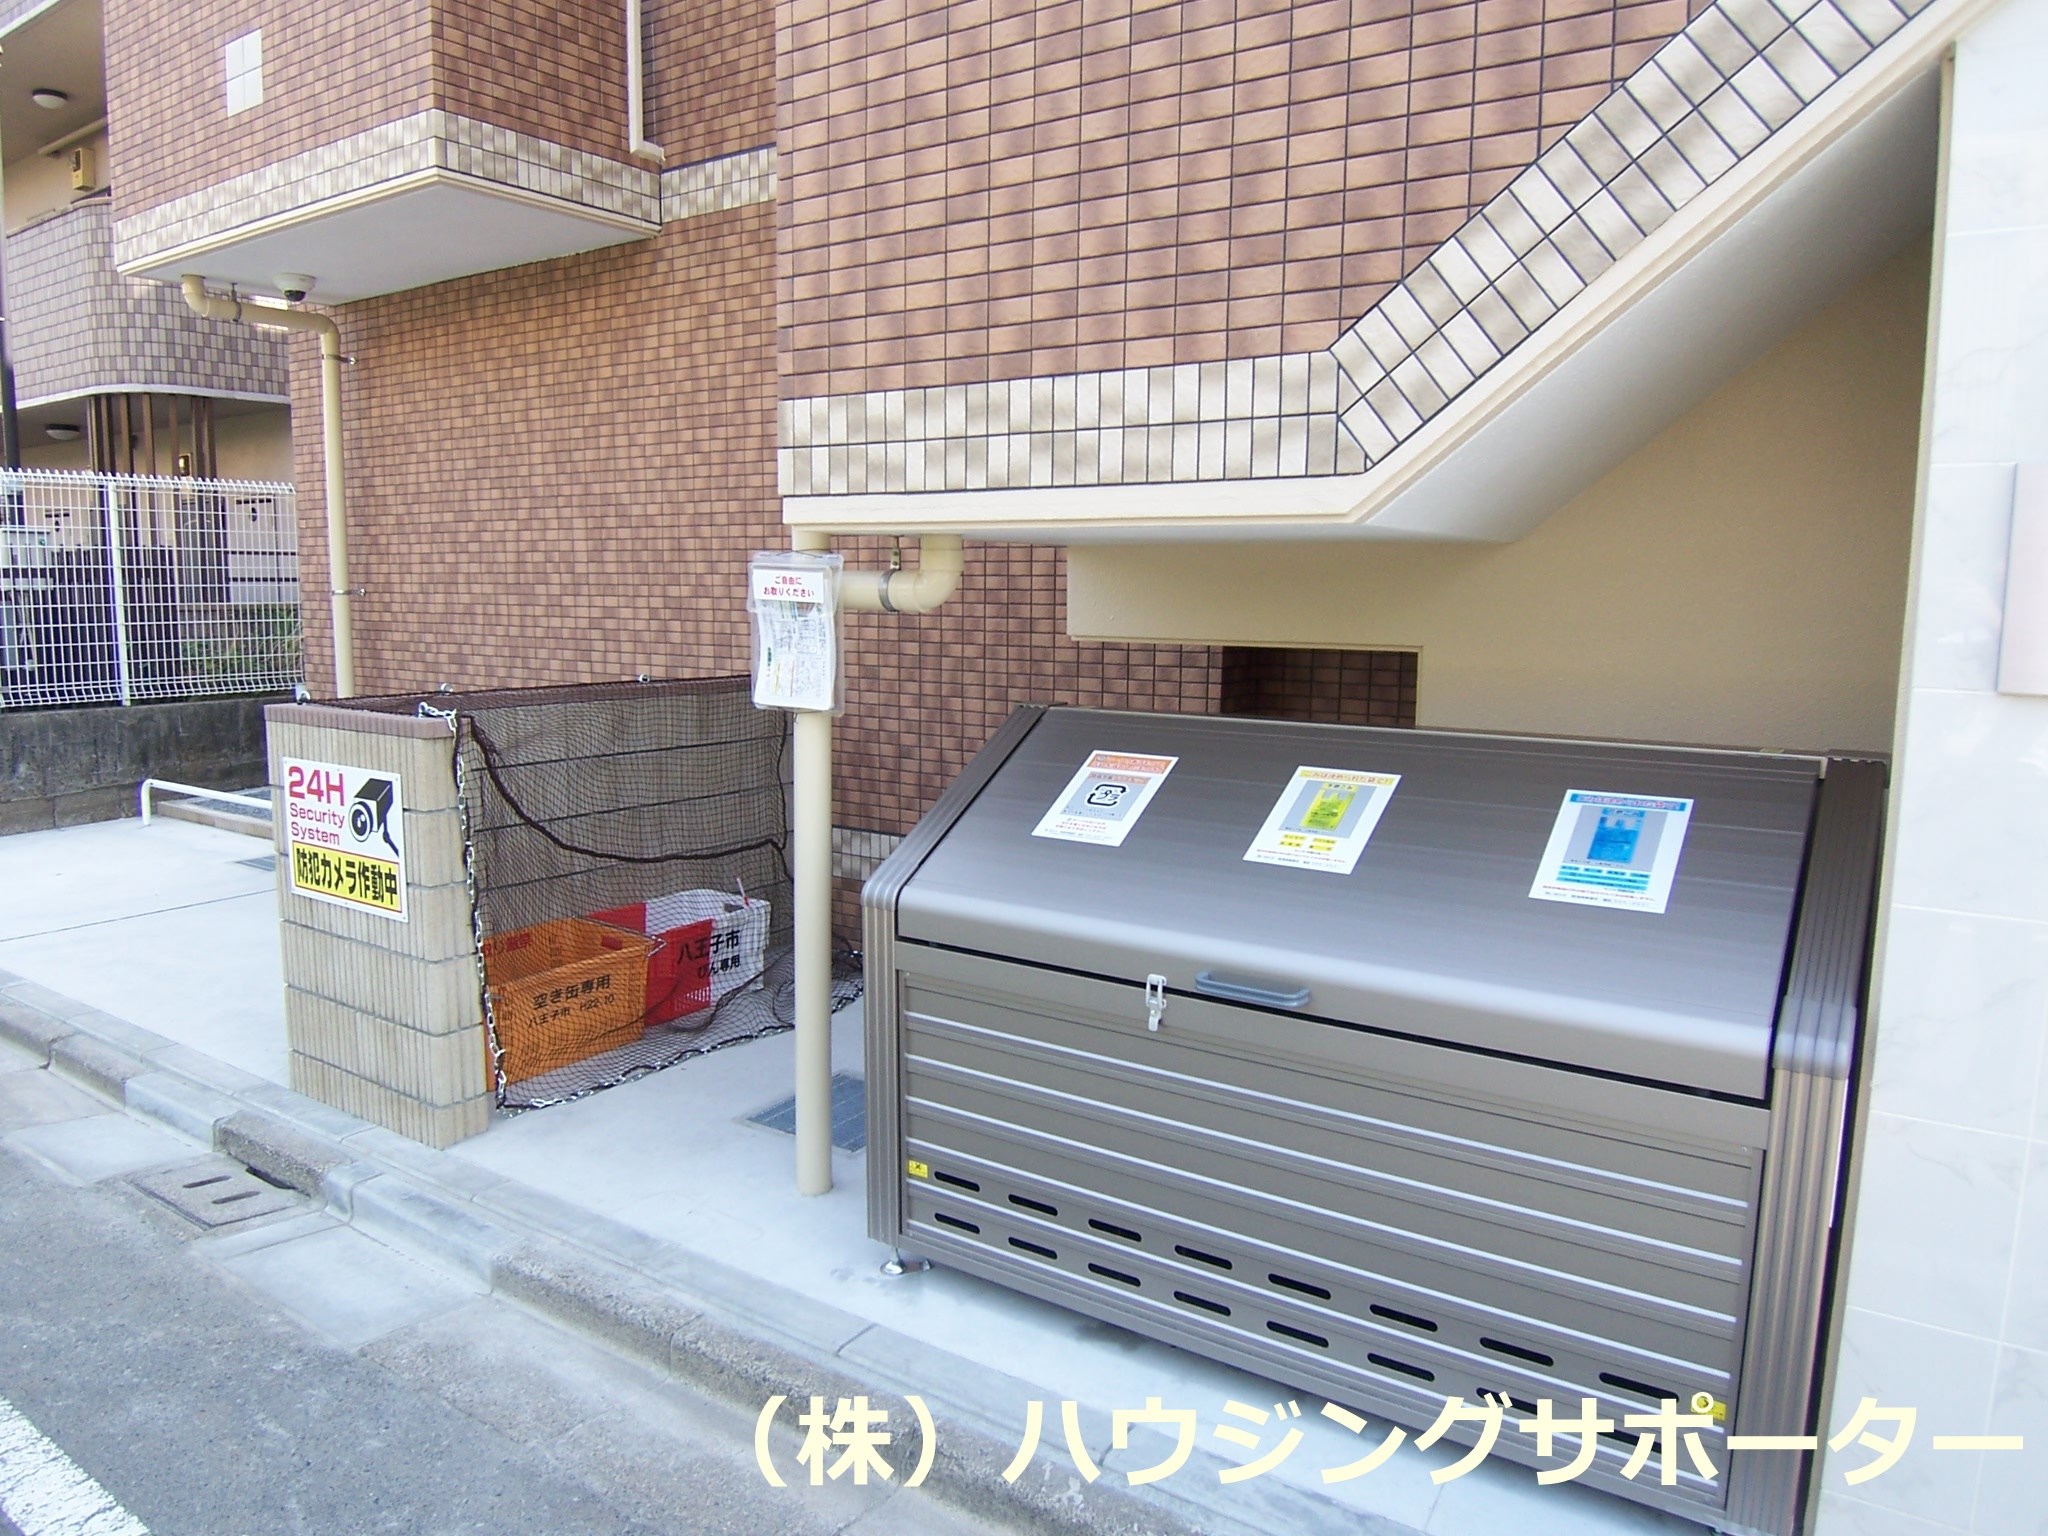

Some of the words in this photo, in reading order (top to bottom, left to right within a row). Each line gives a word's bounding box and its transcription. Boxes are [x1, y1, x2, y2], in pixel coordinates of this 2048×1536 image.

[763, 586, 815, 598] お取りください
[774, 575, 802, 585] ご自由に
[288, 766, 345, 806] 24H
[290, 802, 345, 829] Security
[291, 821, 340, 846] System
[296, 848, 398, 905] 防犯カメラ作動中
[677, 928, 741, 965] 八王子市
[533, 975, 611, 1010] 空き缶専用
[529, 1007, 571, 1028] 八王子市
